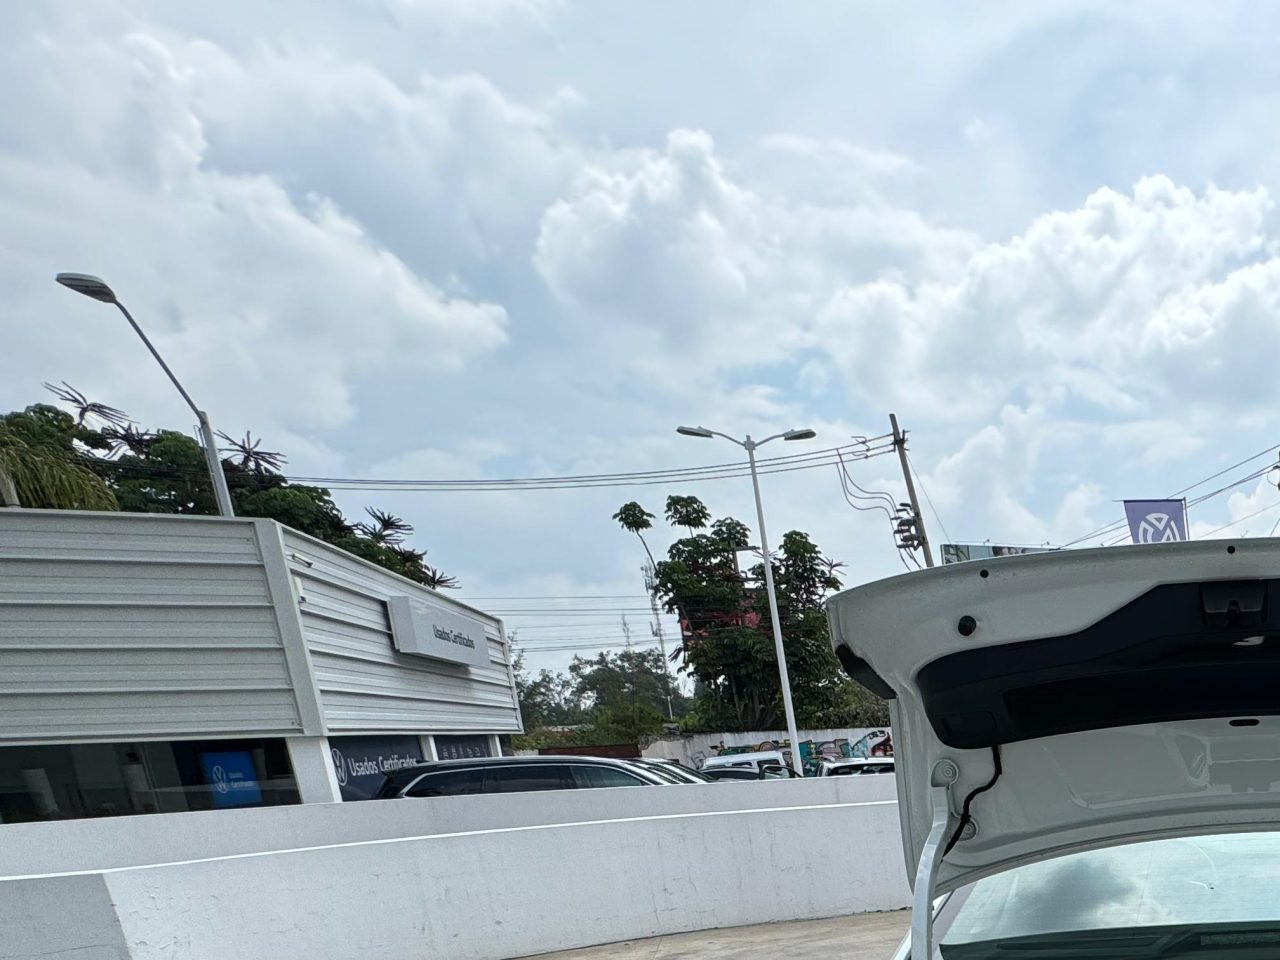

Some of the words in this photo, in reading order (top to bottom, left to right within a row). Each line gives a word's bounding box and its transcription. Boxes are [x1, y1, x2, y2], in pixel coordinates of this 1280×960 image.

[432, 624, 451, 642] Usados
[450, 630, 475, 649] Certificados
[347, 757, 379, 776] Usados
[378, 754, 417, 772] Certificados
